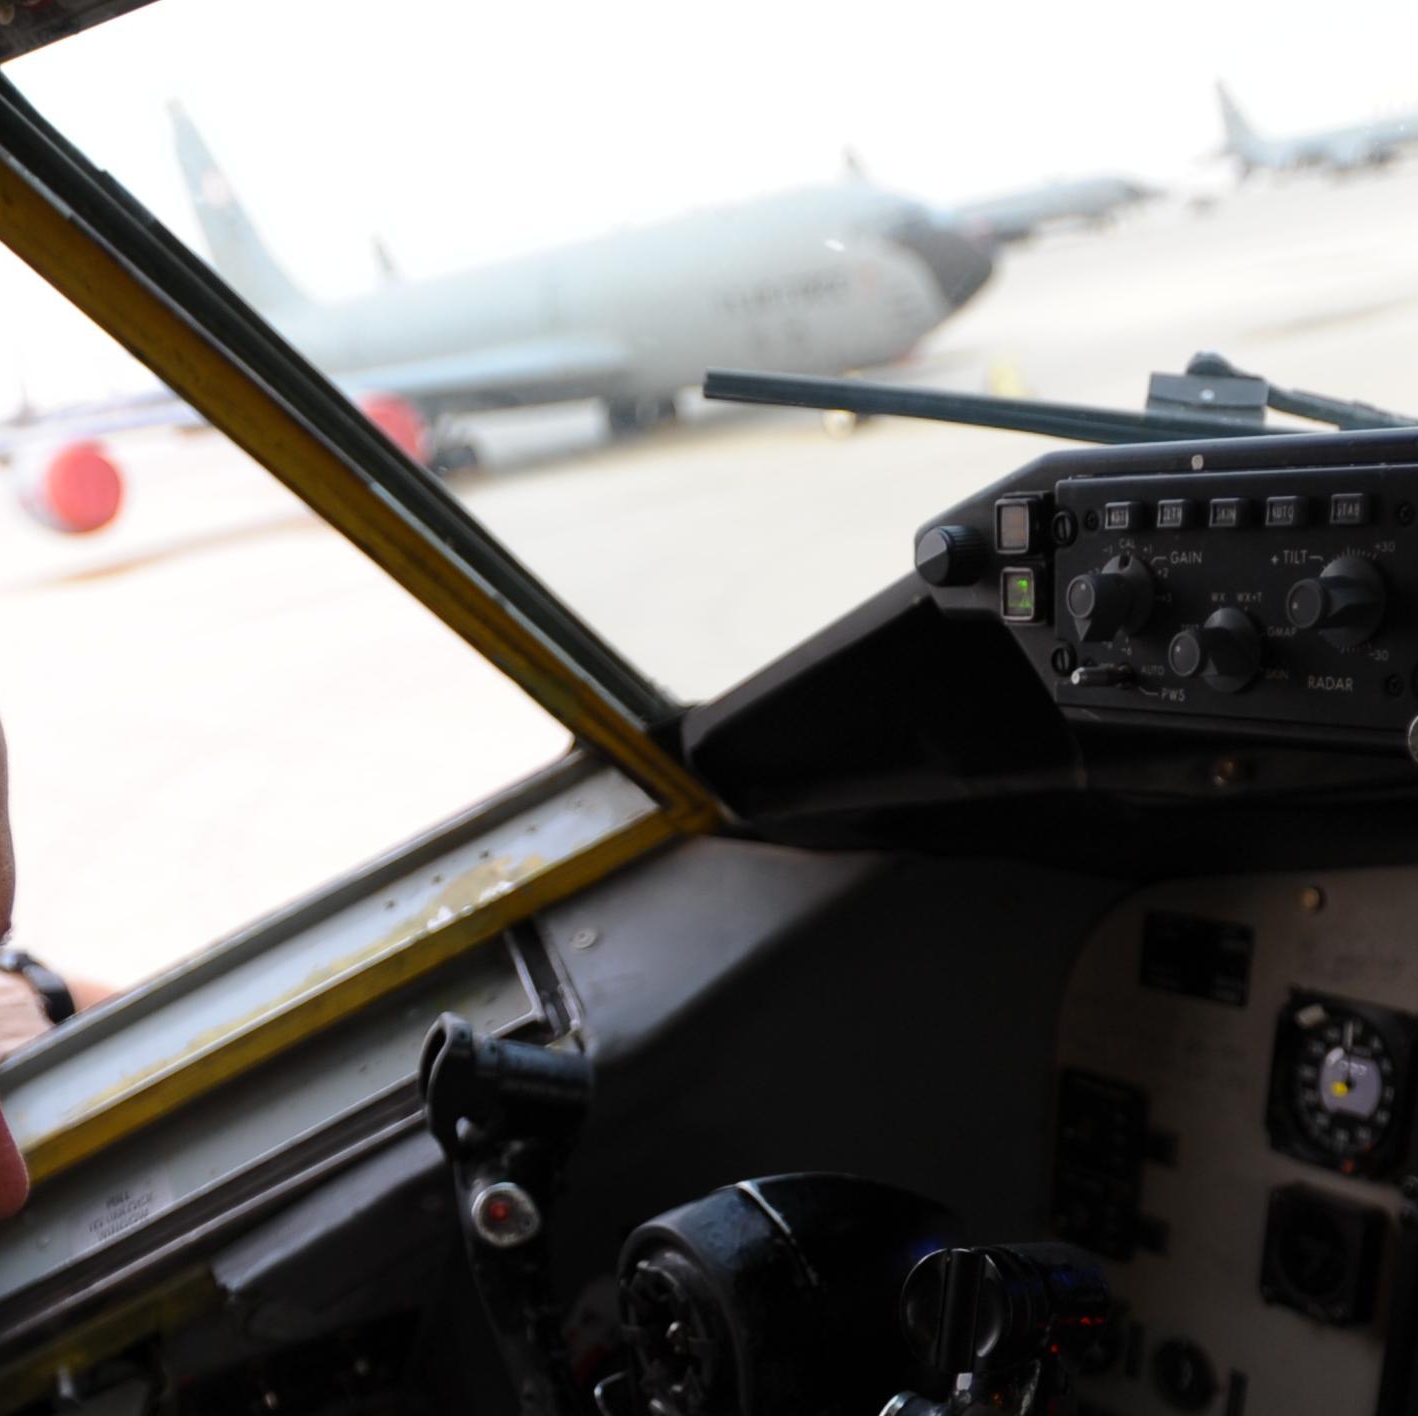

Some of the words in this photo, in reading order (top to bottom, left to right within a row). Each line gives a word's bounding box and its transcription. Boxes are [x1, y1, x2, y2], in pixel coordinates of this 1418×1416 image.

[1169, 551, 1203, 565] GAIN
[1283, 550, 1308, 565] TILT
[1307, 675, 1353, 692] RADAR
[1161, 689, 1186, 702] PWS
